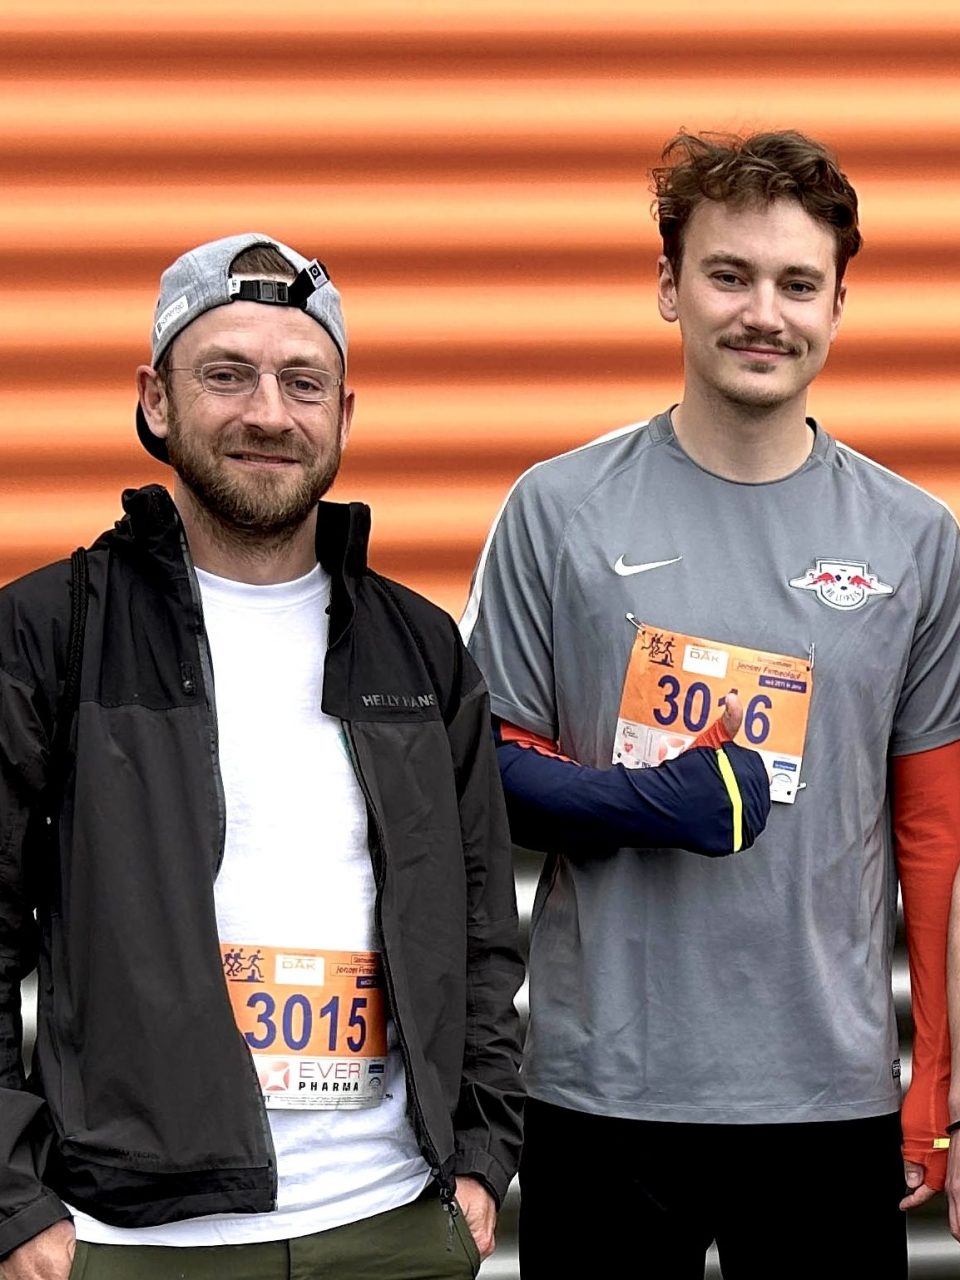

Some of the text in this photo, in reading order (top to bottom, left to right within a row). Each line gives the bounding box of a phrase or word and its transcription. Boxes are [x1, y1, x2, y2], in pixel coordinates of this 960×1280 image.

[361, 694, 400, 707] HELLY
[653, 675, 772, 745] 306
[244, 992, 367, 1053] 3015
[299, 1061, 361, 1079] EVER
[298, 1081, 359, 1092] PHARMA
